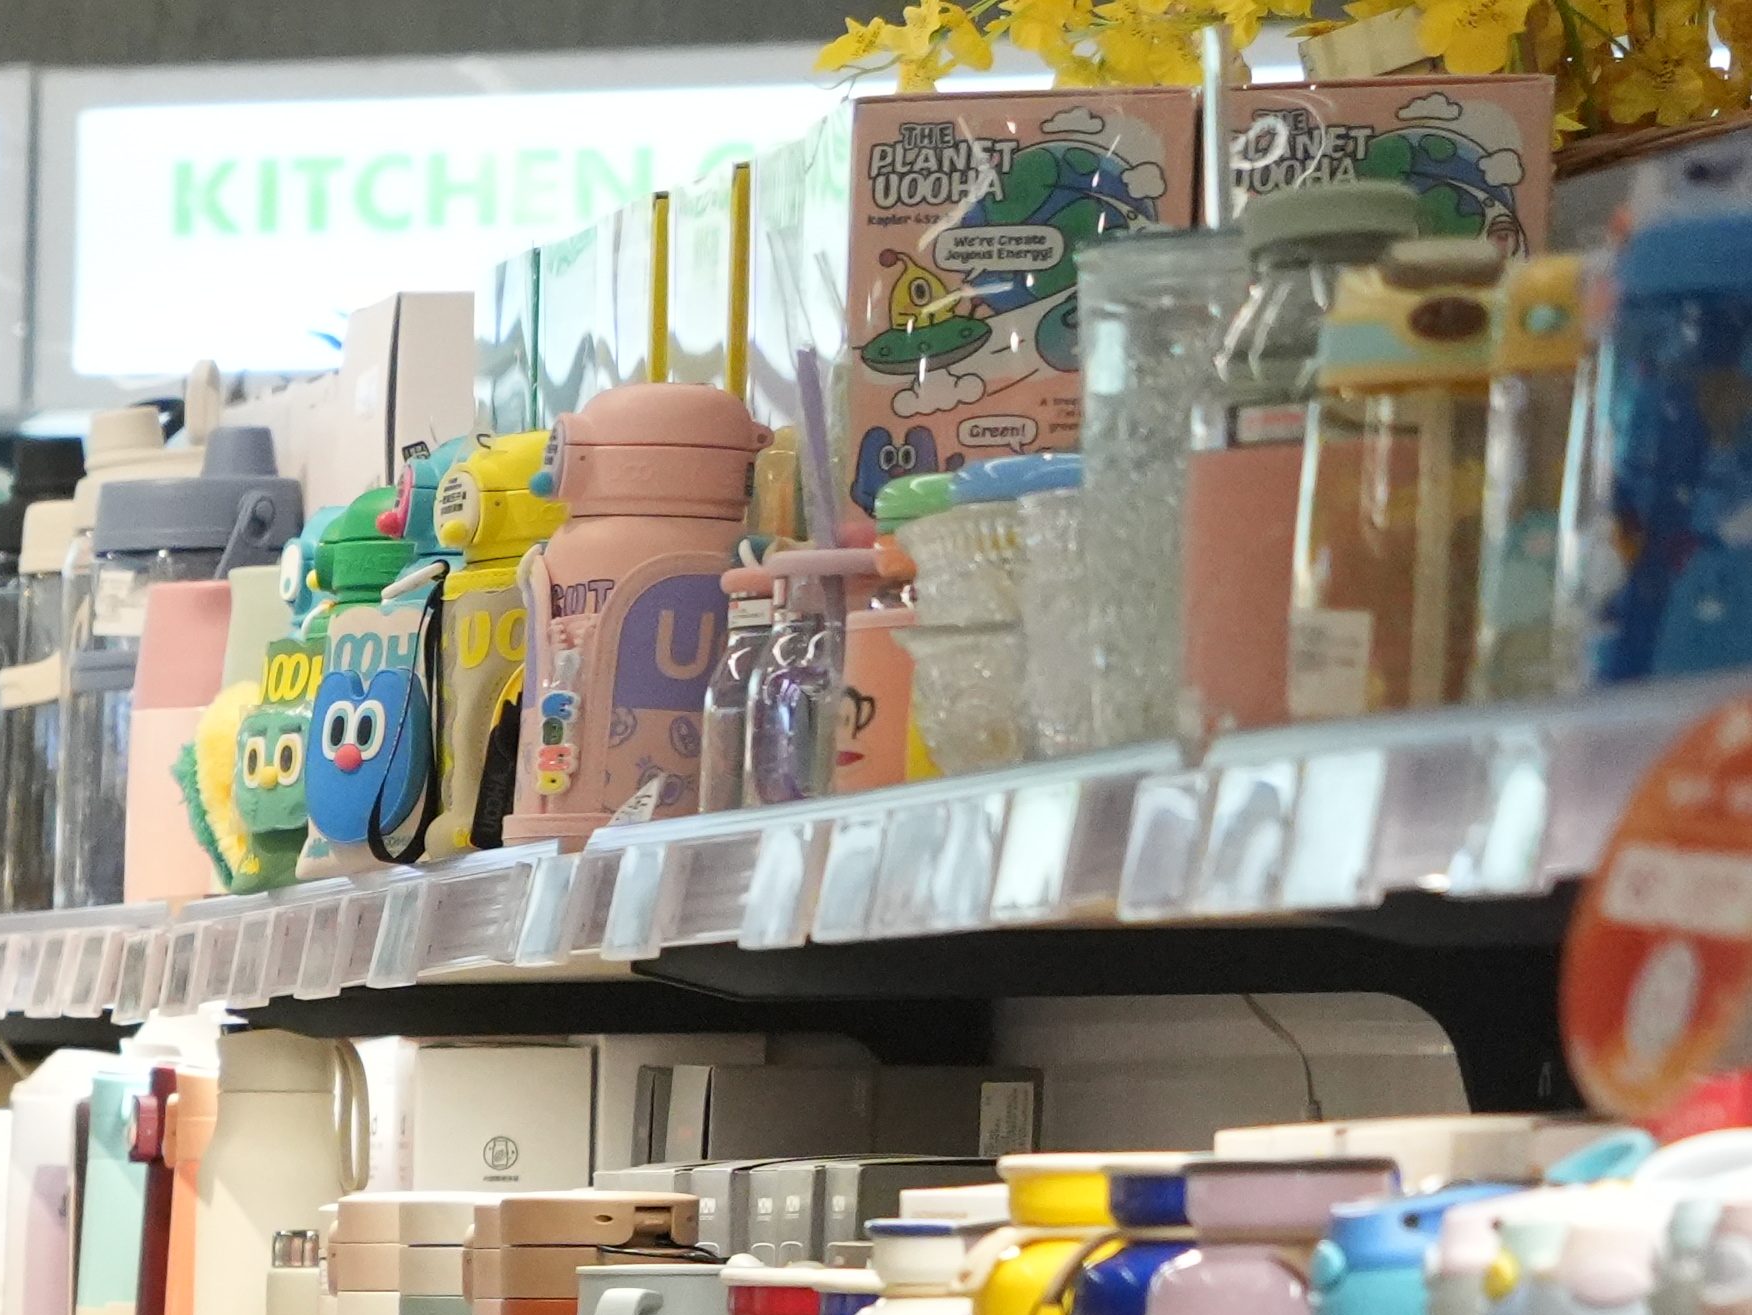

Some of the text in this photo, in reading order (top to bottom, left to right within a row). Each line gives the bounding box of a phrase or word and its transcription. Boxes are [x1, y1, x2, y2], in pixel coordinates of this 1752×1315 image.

[901, 122, 955, 148] THE
[870, 138, 1019, 179] PLANET
[171, 148, 652, 237] KITCHEN
[954, 234, 1047, 247] We're Create
[997, 246, 1054, 261] Energy!
[969, 424, 1026, 438] Green!
